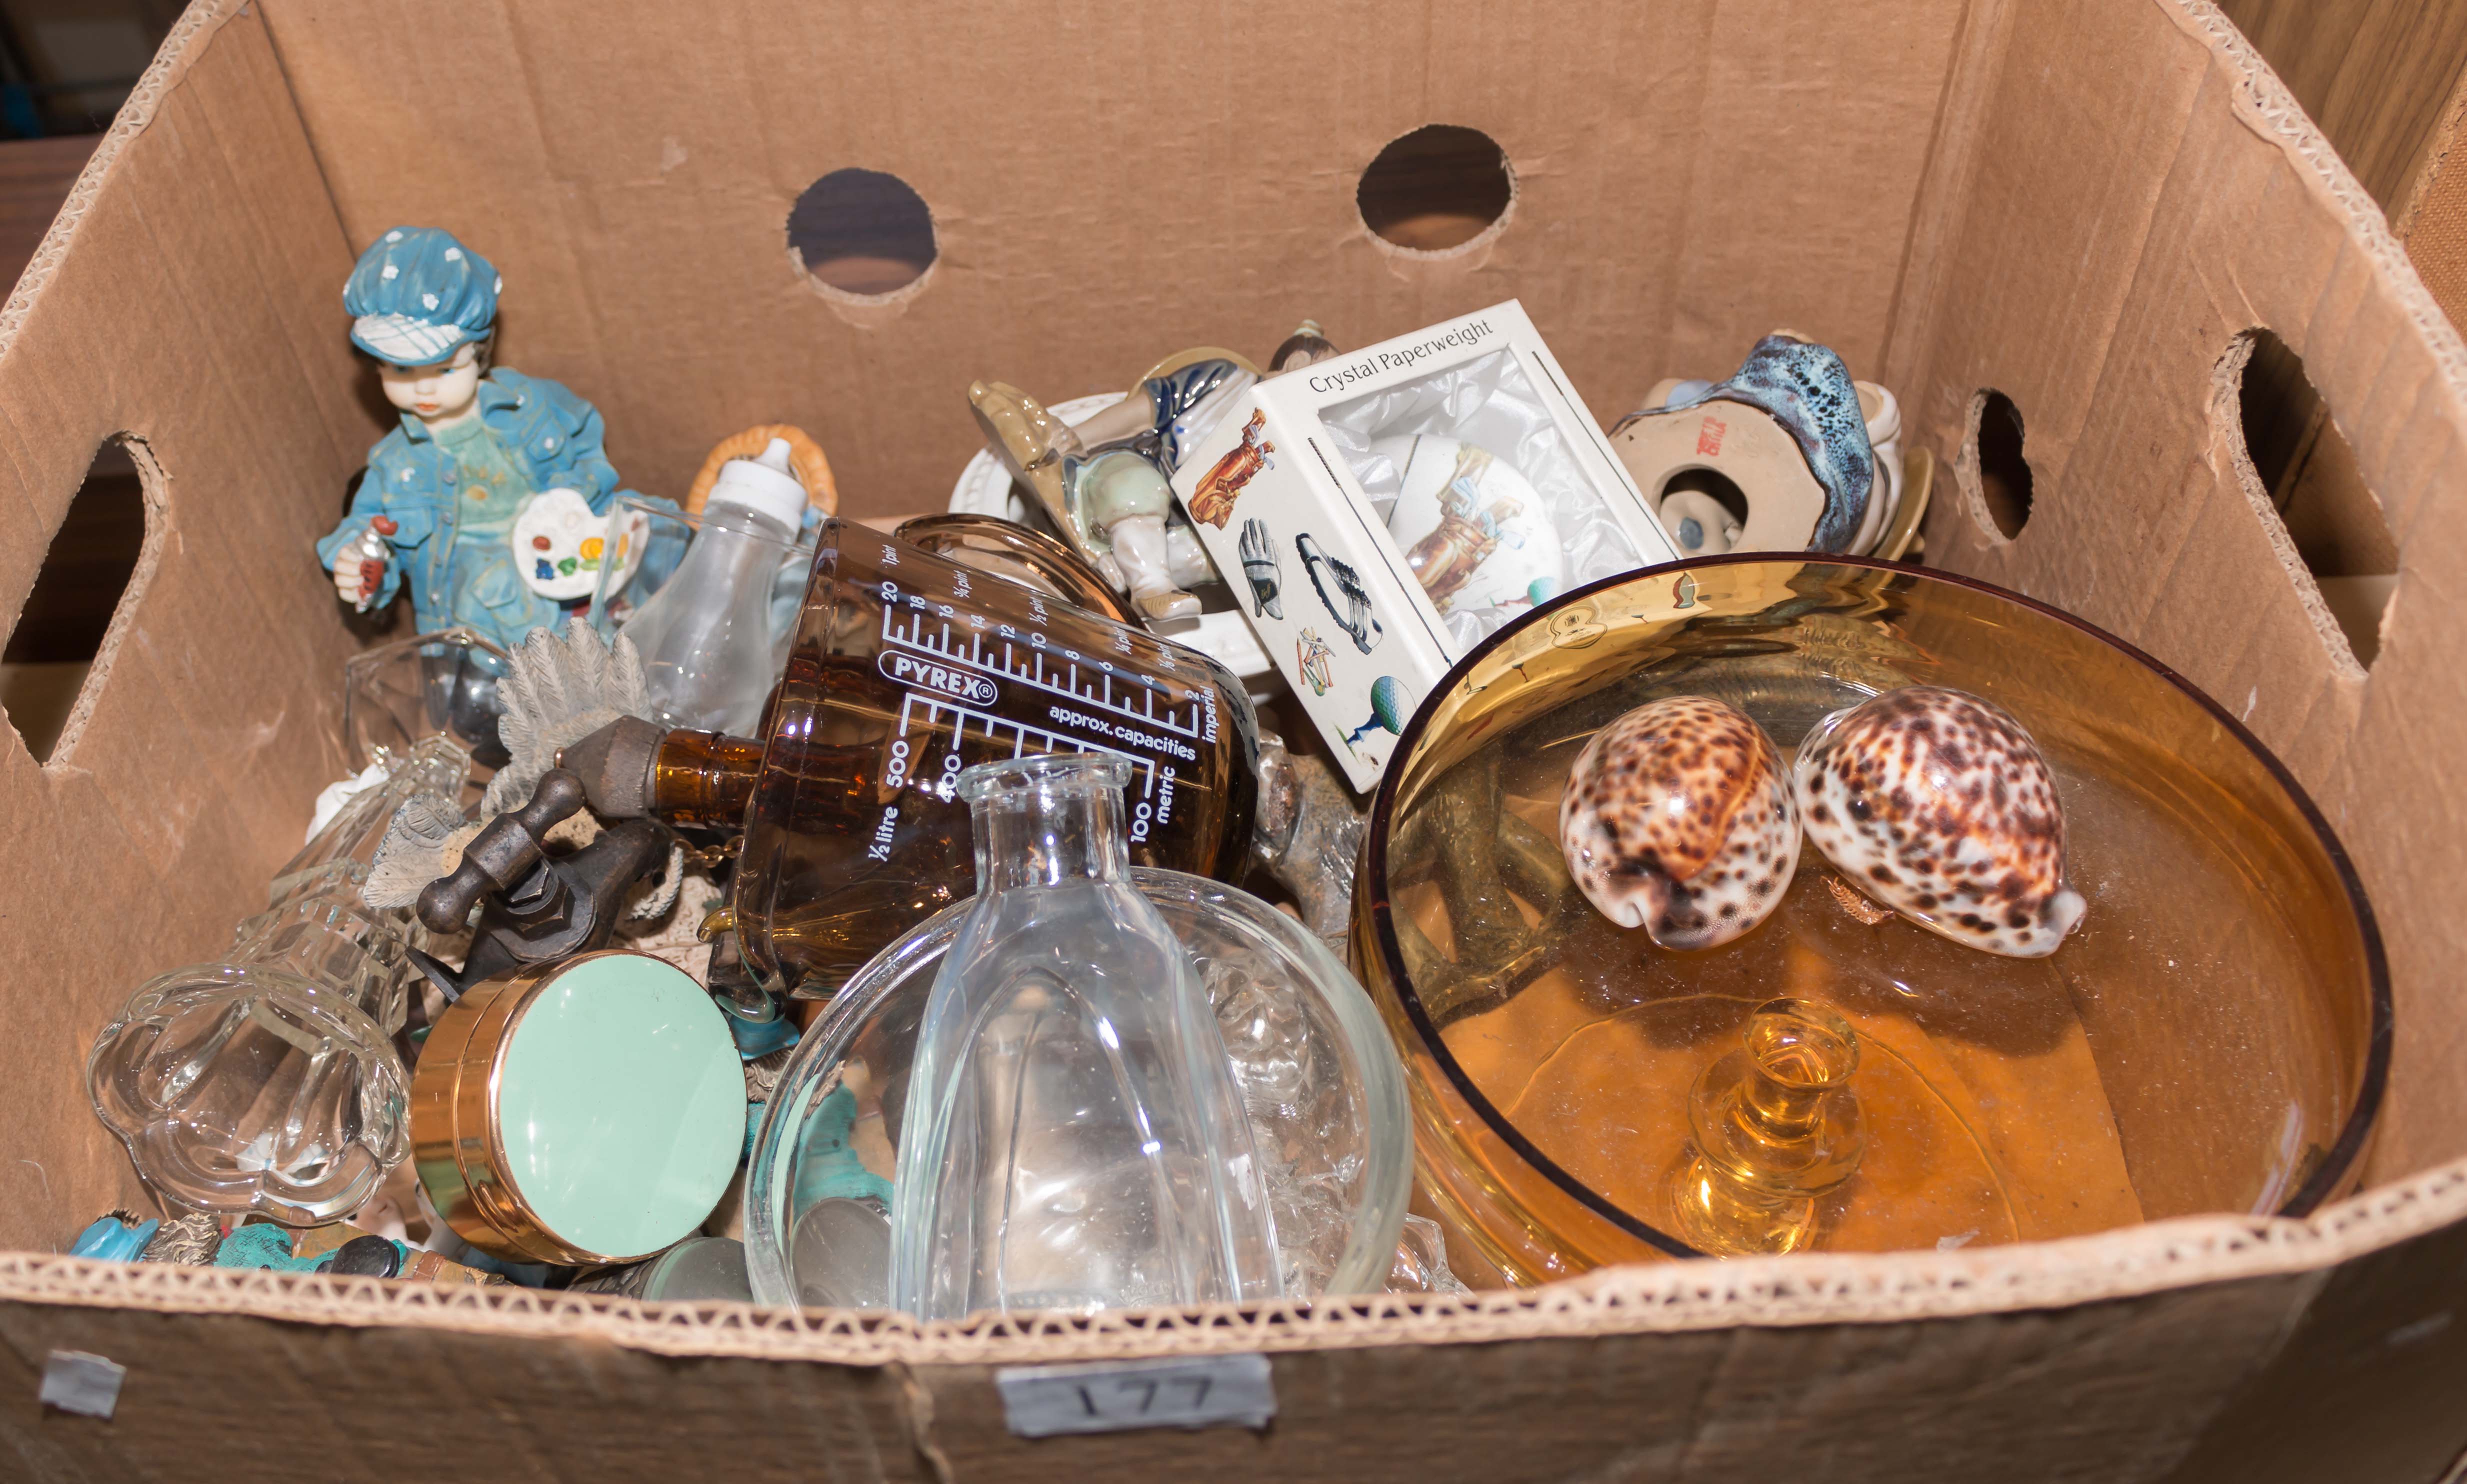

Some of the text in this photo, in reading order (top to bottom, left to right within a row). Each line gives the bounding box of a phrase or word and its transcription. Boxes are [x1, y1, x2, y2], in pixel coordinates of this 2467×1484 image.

[1309, 319, 1494, 392] Crystal Paperweight
[953, 570, 972, 590] pint
[881, 581, 898, 602] 20
[910, 595, 926, 610] 18
[938, 604, 954, 618] 16
[1028, 596, 1049, 616] pint
[970, 614, 986, 629] 14
[1000, 624, 1016, 638] 12
[1031, 632, 1047, 650] 10
[1112, 626, 1134, 646] pint
[1064, 650, 1080, 660] 8
[1158, 642, 1176, 662] pint
[1098, 661, 1114, 672] 6
[1140, 674, 1156, 686] 4
[1184, 690, 1200, 701] 2
[1200, 685, 1220, 744] imperial
[1049, 706, 1196, 761] approx. capacities
[886, 740, 910, 788] 500
[938, 754, 962, 803] 400
[1156, 766, 1176, 824] metric
[875, 806, 898, 843] litre
[1130, 802, 1152, 842] 100
[1076, 1376, 1212, 1416] 177
